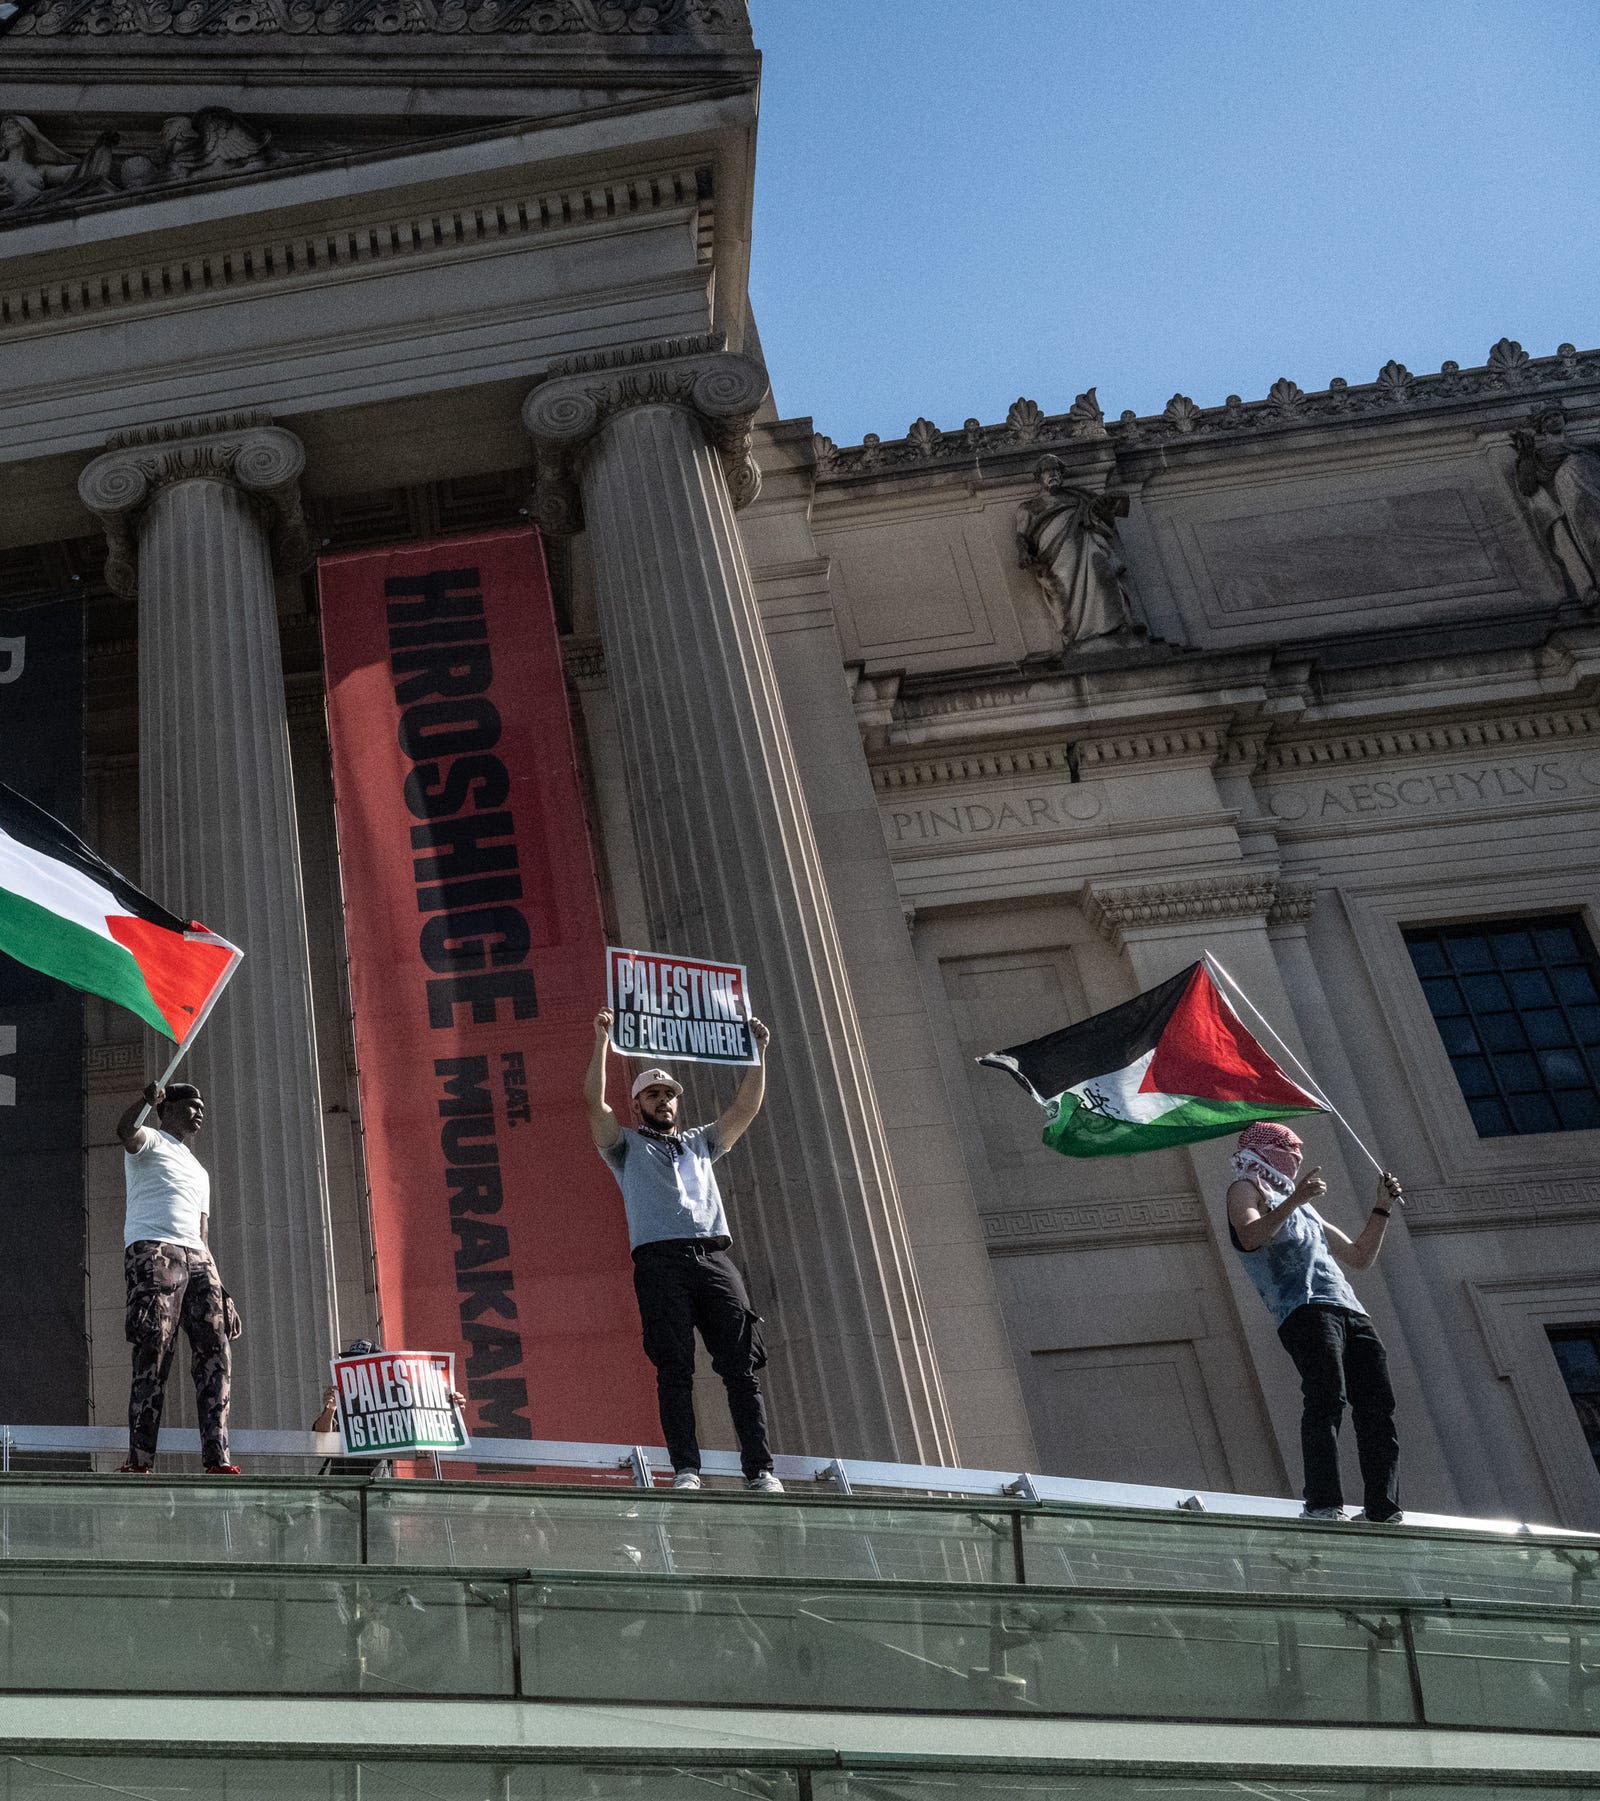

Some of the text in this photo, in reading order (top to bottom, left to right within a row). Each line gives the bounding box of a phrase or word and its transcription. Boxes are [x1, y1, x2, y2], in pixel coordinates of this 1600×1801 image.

[384, 567, 538, 1029] HIROSHIGE
[1320, 762, 1568, 816] AESCHYLVS
[891, 798, 1060, 840] PINDAR
[617, 958, 744, 1022] PALESTINE
[618, 1011, 748, 1057] IS EVERYWHERE
[500, 1051, 532, 1128] FEAT.
[340, 1359, 451, 1415] PALESTINE
[347, 1409, 460, 1448] IS EVERYWHERE
